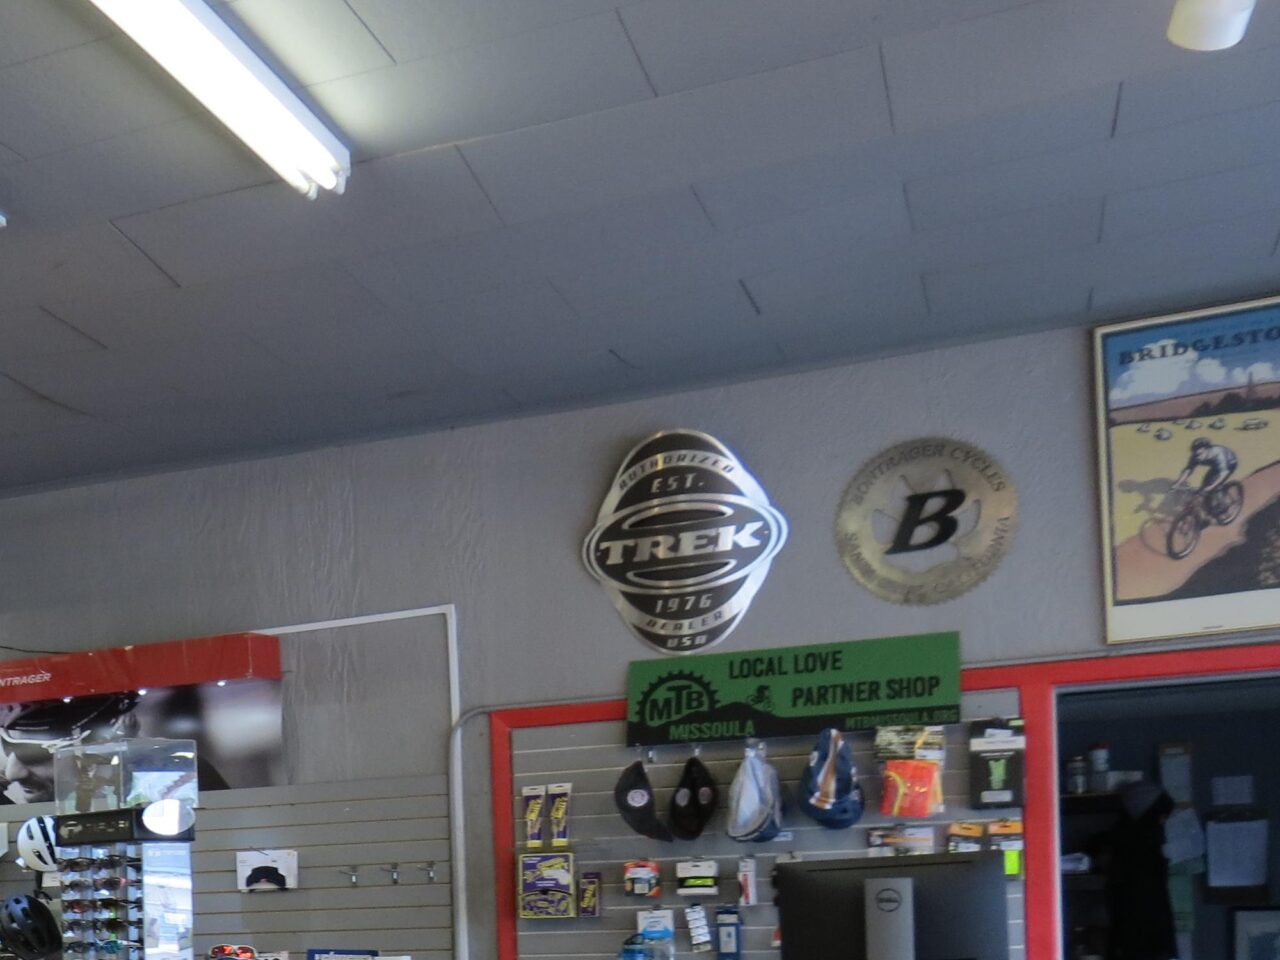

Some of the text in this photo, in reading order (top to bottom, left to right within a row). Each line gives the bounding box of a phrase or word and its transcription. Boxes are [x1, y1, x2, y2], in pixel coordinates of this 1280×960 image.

[619, 453, 736, 492] AUTHORIZED
[650, 473, 705, 493] EST.
[884, 488, 967, 556] B
[598, 521, 765, 566] TREK
[655, 594, 714, 614] 1976
[646, 611, 723, 632] DEALER
[666, 634, 708, 648] USA
[728, 650, 844, 680] LOCAL LOVE
[647, 684, 705, 722] MTB
[790, 675, 941, 708] PARTNER SHOP
[669, 719, 757, 740] MISSOULA
